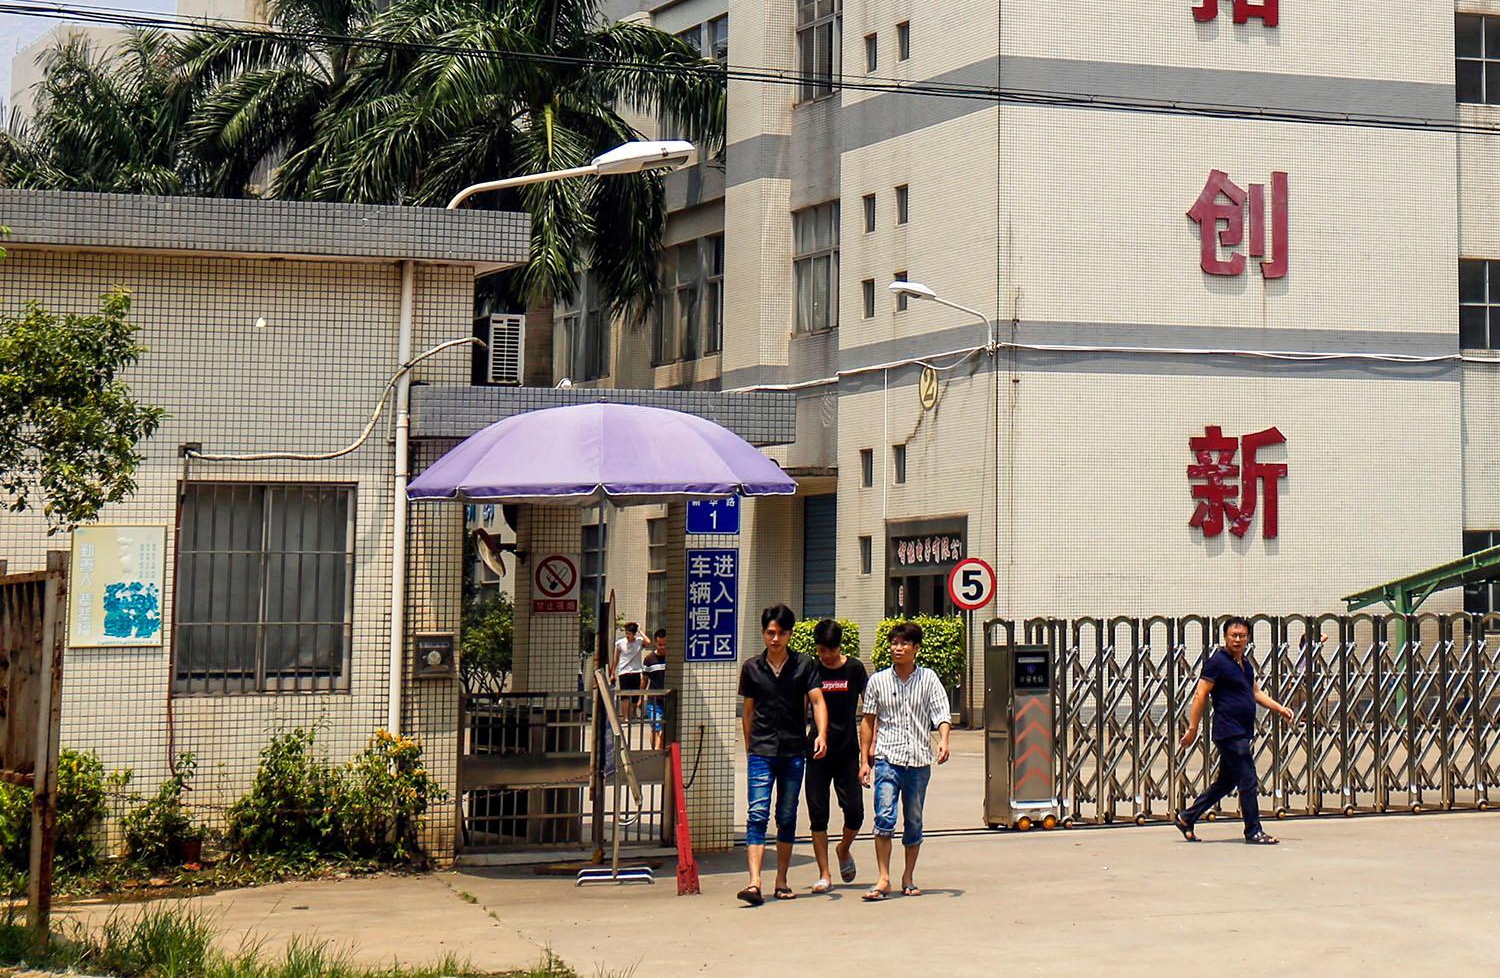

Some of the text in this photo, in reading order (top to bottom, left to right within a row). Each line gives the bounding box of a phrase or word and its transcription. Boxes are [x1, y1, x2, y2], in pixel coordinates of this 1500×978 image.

[923, 368, 935, 402] 2
[709, 510, 717, 530] 1
[962, 570, 984, 601] 5
[689, 555, 711, 657] 车辆慢行
[713, 555, 735, 656] 进入厂区
